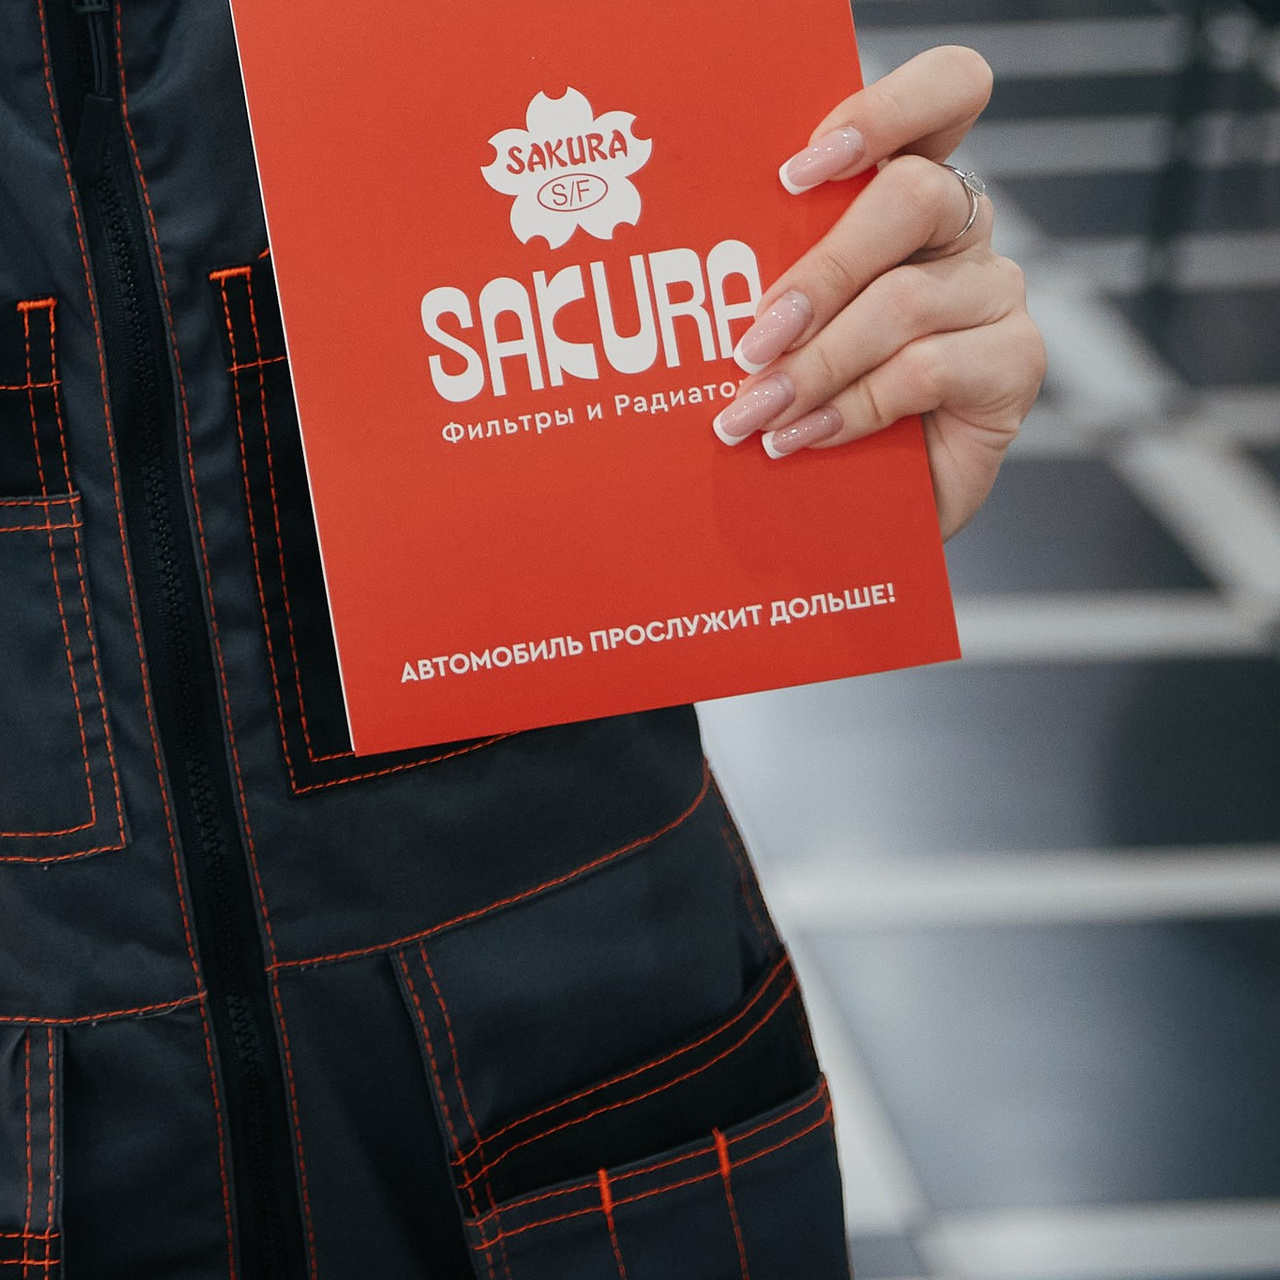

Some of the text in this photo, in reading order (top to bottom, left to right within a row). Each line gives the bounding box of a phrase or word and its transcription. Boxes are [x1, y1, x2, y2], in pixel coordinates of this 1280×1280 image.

[506, 129, 628, 175] SAKURA
[551, 179, 590, 207] S/F
[420, 239, 764, 403] SAKURA
[441, 378, 743, 444] Фильтры и Радиато
[400, 582, 897, 684] АВТОМОБИЛЬ ПРОСЛУЖИТ ДОЛЬШЕ!
